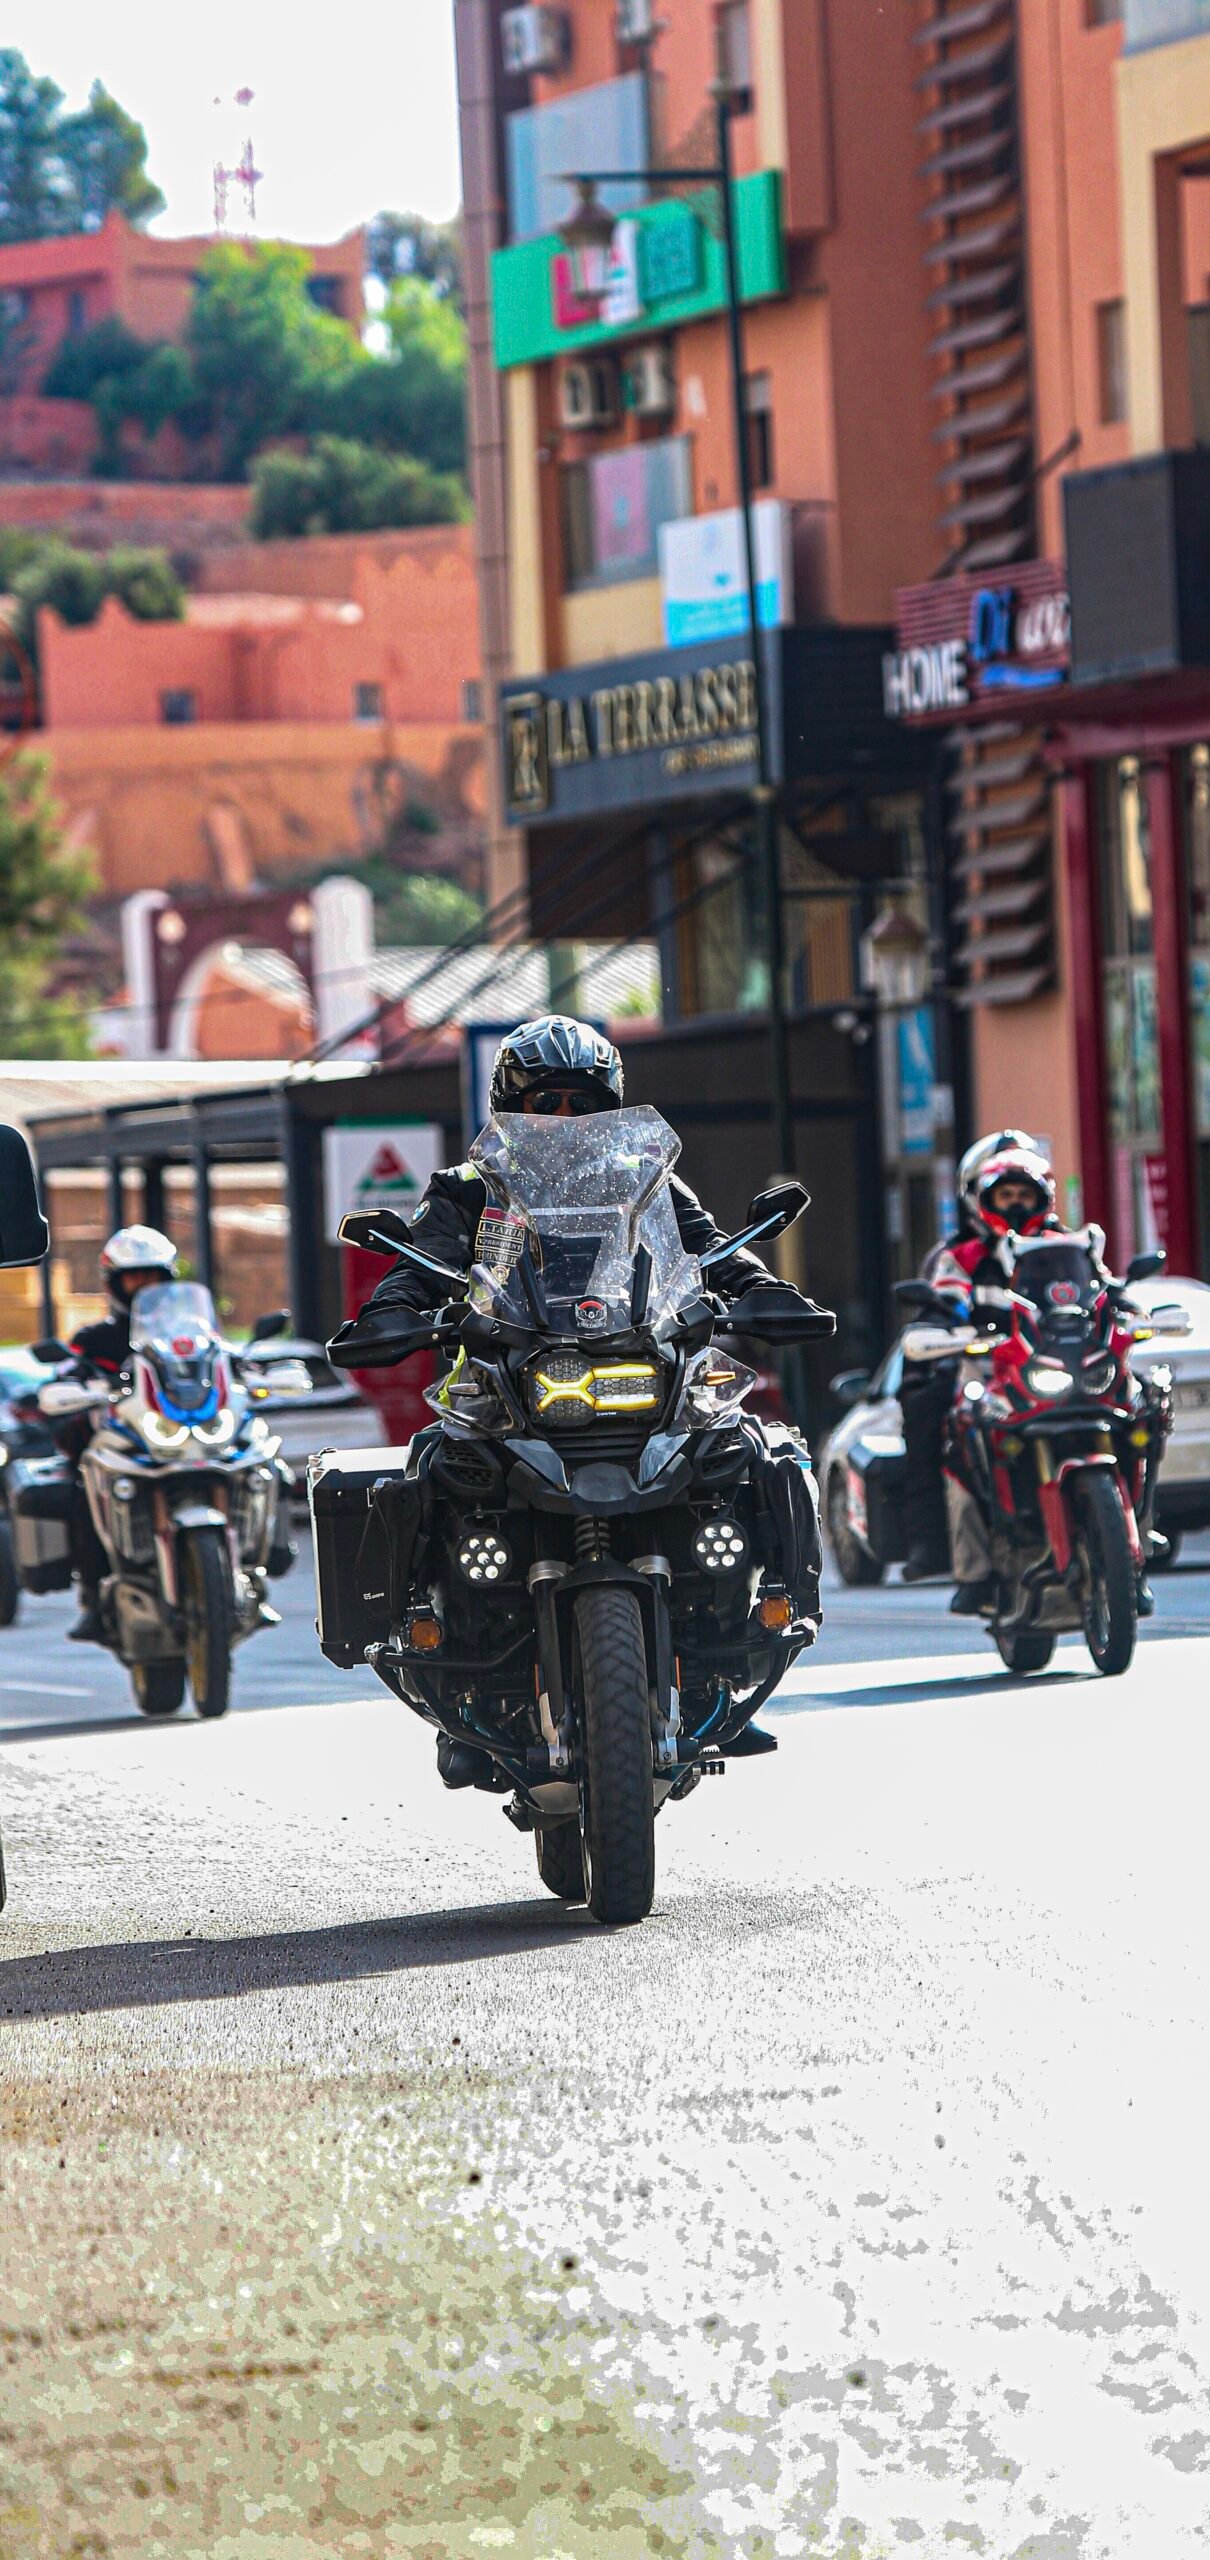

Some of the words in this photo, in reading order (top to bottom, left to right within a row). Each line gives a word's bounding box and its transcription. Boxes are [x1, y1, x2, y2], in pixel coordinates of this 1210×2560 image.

[547, 697, 590, 767] LA
[591, 659, 758, 758] TERRASSE
[882, 638, 969, 719] HOME
